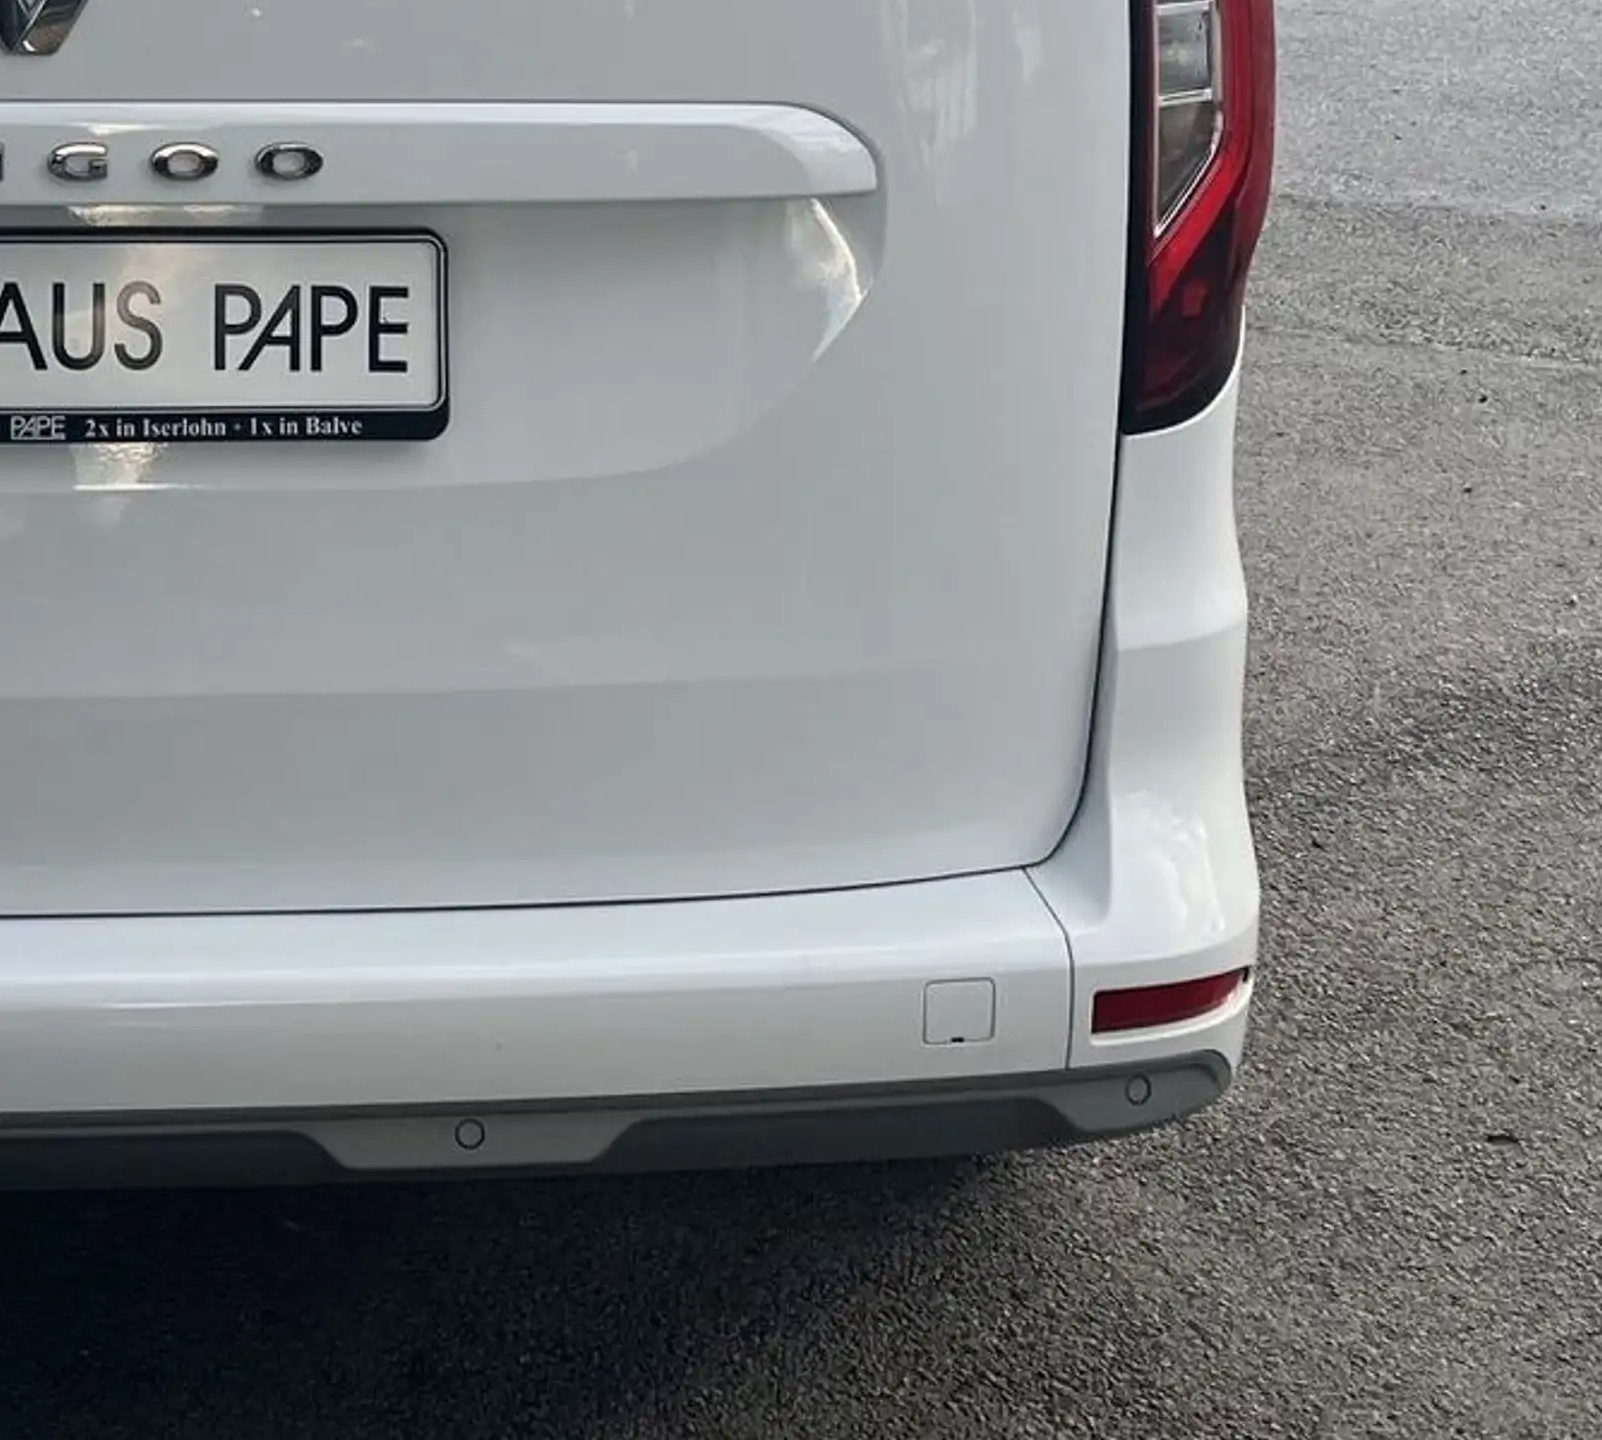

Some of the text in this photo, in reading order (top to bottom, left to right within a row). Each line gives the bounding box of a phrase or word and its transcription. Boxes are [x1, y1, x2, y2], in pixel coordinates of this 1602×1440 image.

[213, 283, 410, 373] PAPE
[11, 416, 66, 440] PAPE
[85, 419, 109, 438] 2x
[116, 418, 135, 437] in
[143, 417, 226, 437] Iserlohn
[279, 416, 299, 435] in
[305, 416, 363, 436] Balve
